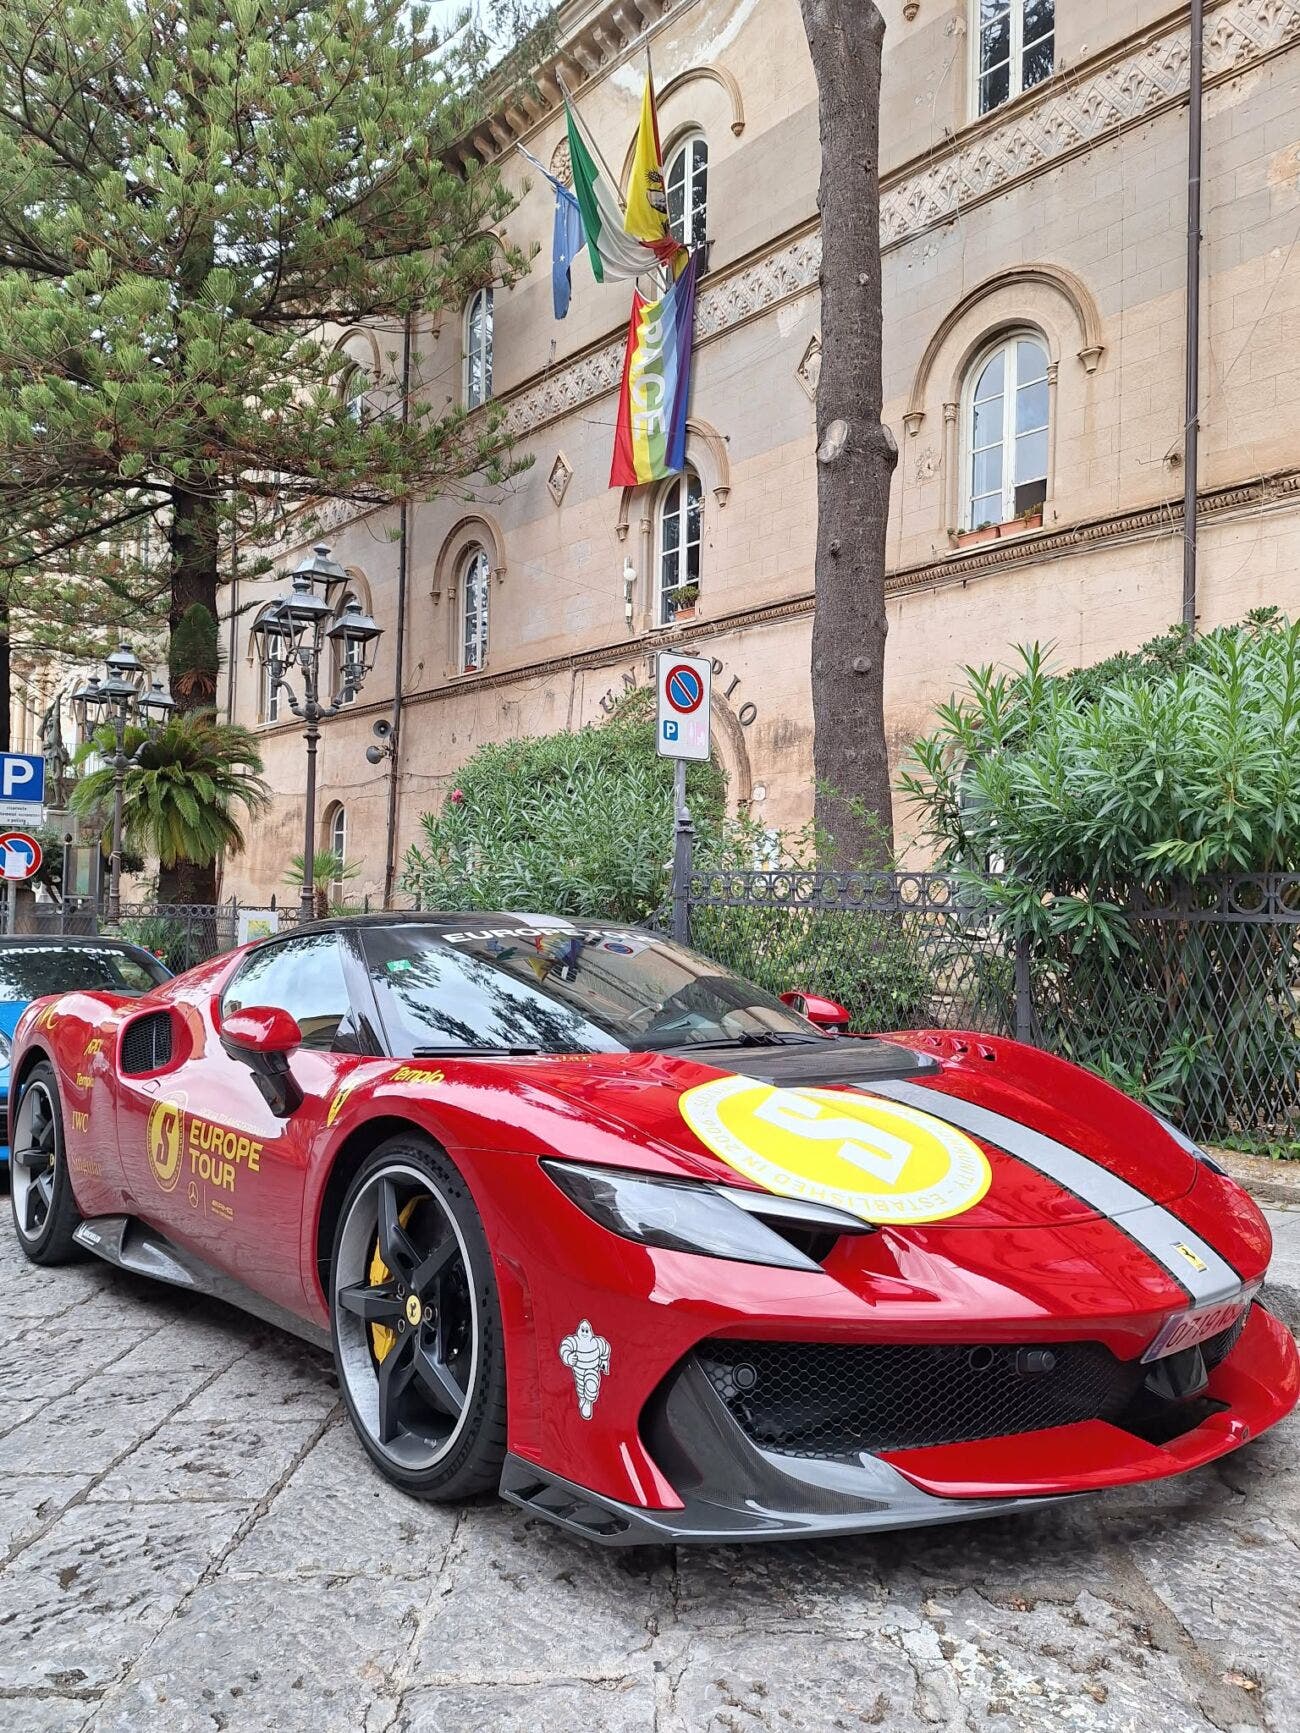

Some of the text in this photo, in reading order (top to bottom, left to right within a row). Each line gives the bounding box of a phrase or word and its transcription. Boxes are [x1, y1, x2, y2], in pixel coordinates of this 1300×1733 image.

[632, 319, 667, 441] PACE
[666, 721, 676, 738] P
[3, 757, 34, 796] P
[67, 946, 126, 957] TOUR
[442, 927, 583, 944] EUROPE
[71, 1110, 89, 1133] IWC
[189, 1118, 264, 1172] EUROPE
[189, 1147, 236, 1193] TOUR
[772, 1173, 947, 1214] ESTABLISHED
